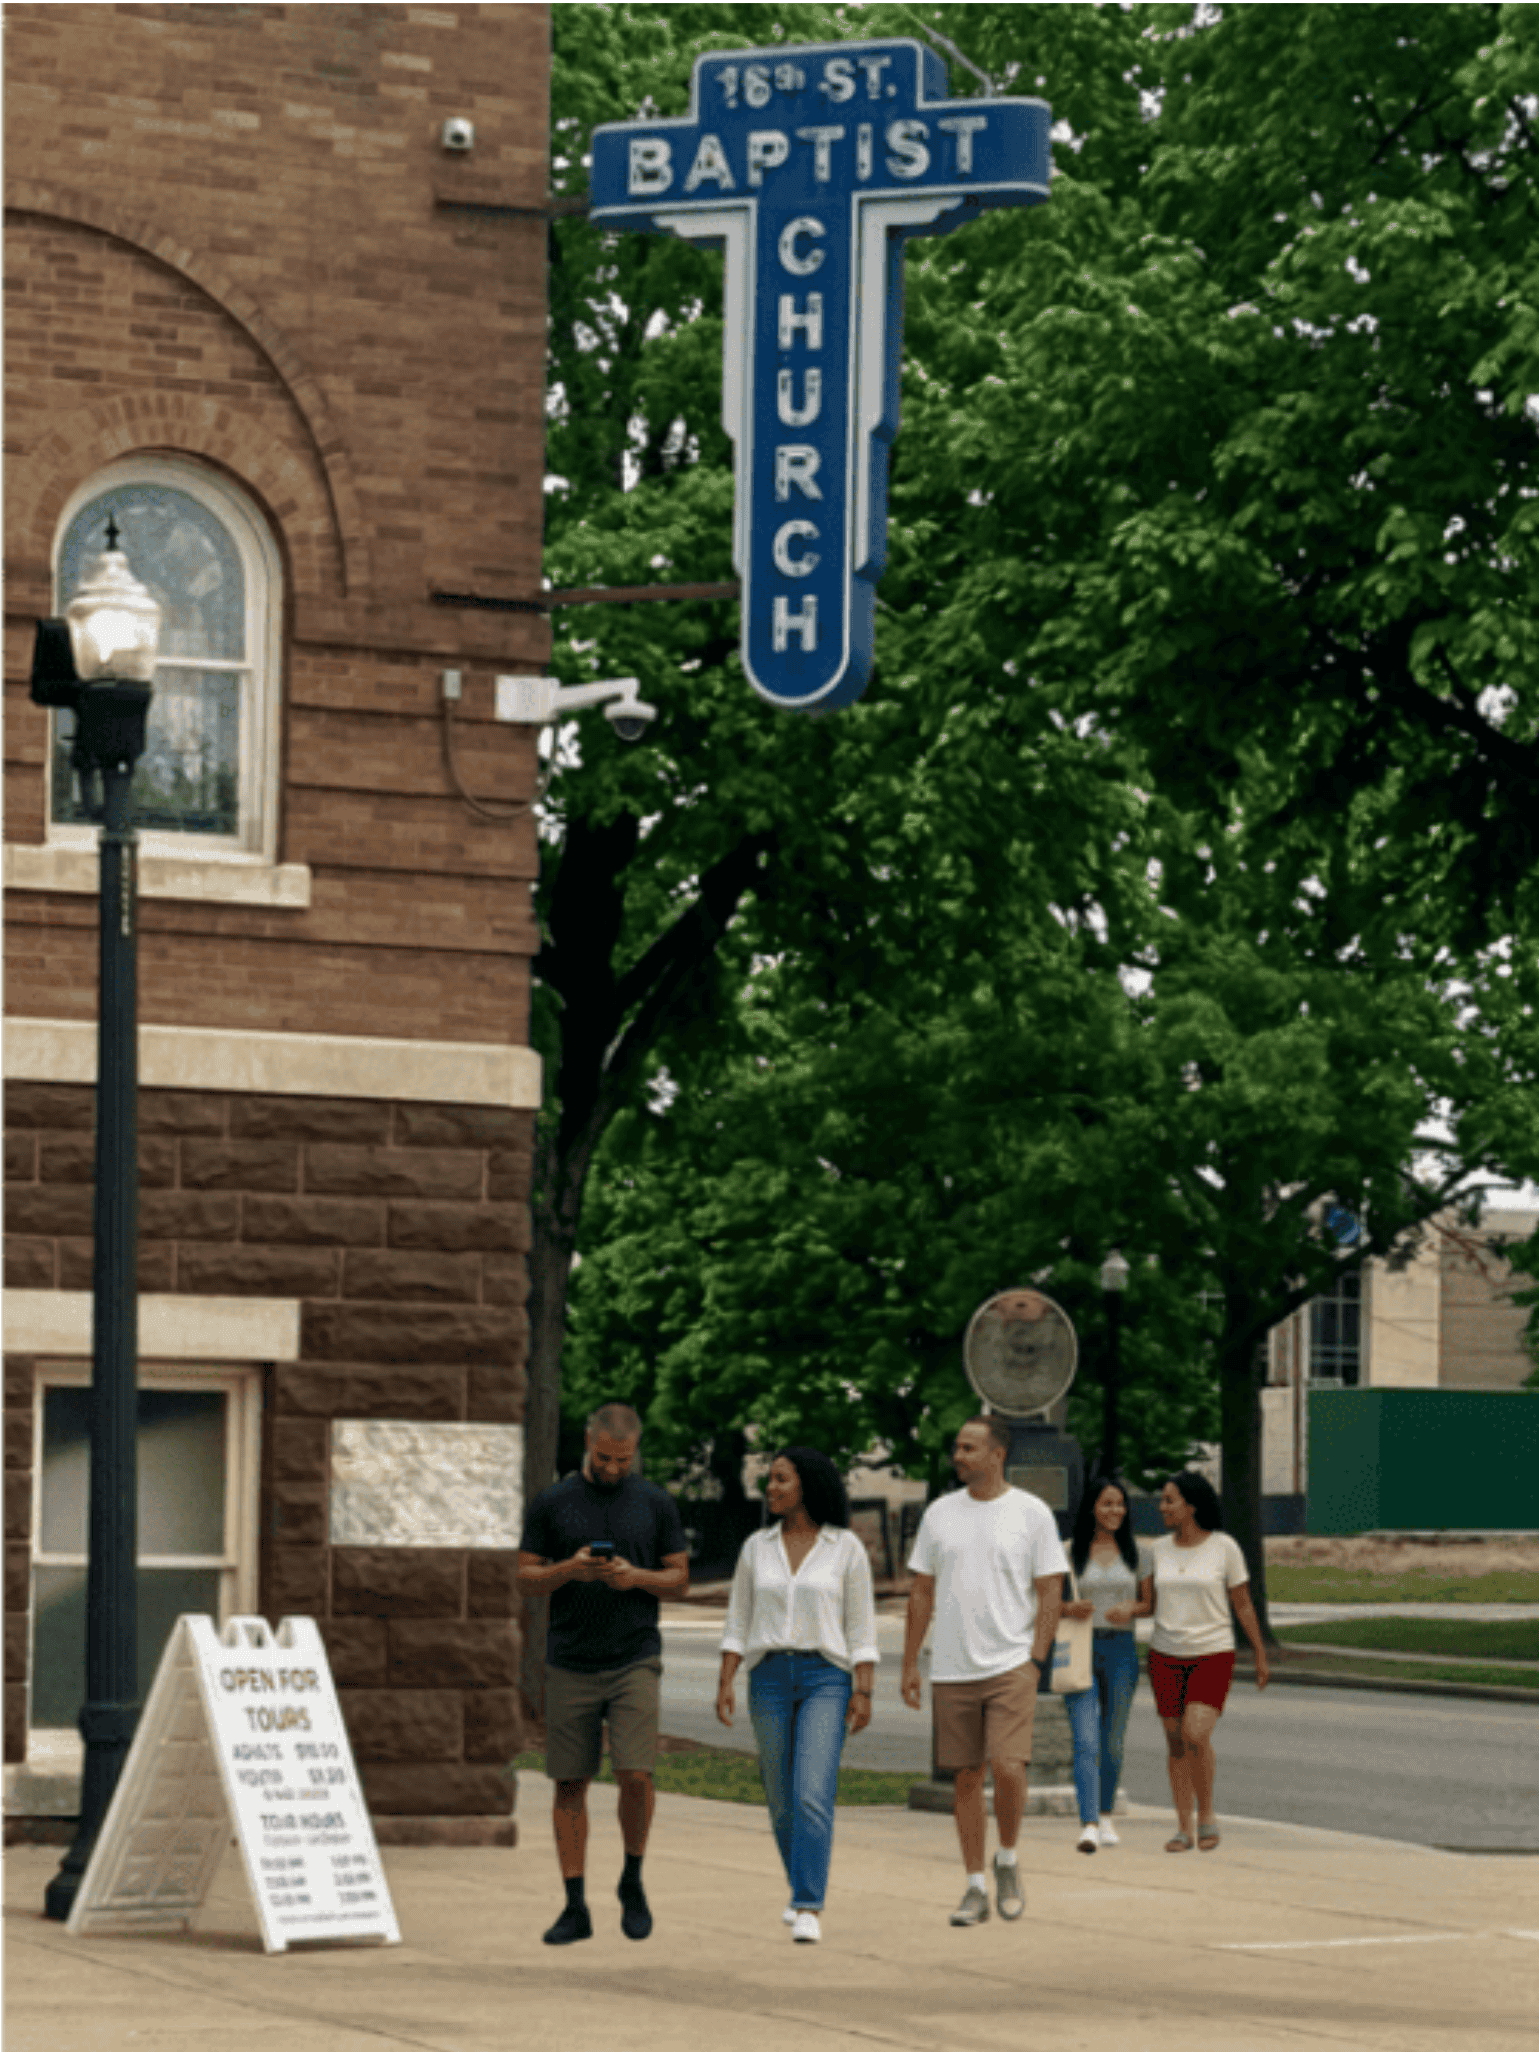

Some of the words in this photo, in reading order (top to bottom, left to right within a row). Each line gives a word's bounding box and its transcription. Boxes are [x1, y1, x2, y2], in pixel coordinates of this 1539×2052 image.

[818, 55, 897, 103] ST.
[627, 115, 988, 195] BAPTIST
[771, 216, 826, 652] CHURCH
[220, 1667, 275, 1693] OPEN
[277, 1667, 321, 1693] FOR
[243, 1705, 312, 1731] TOURS
